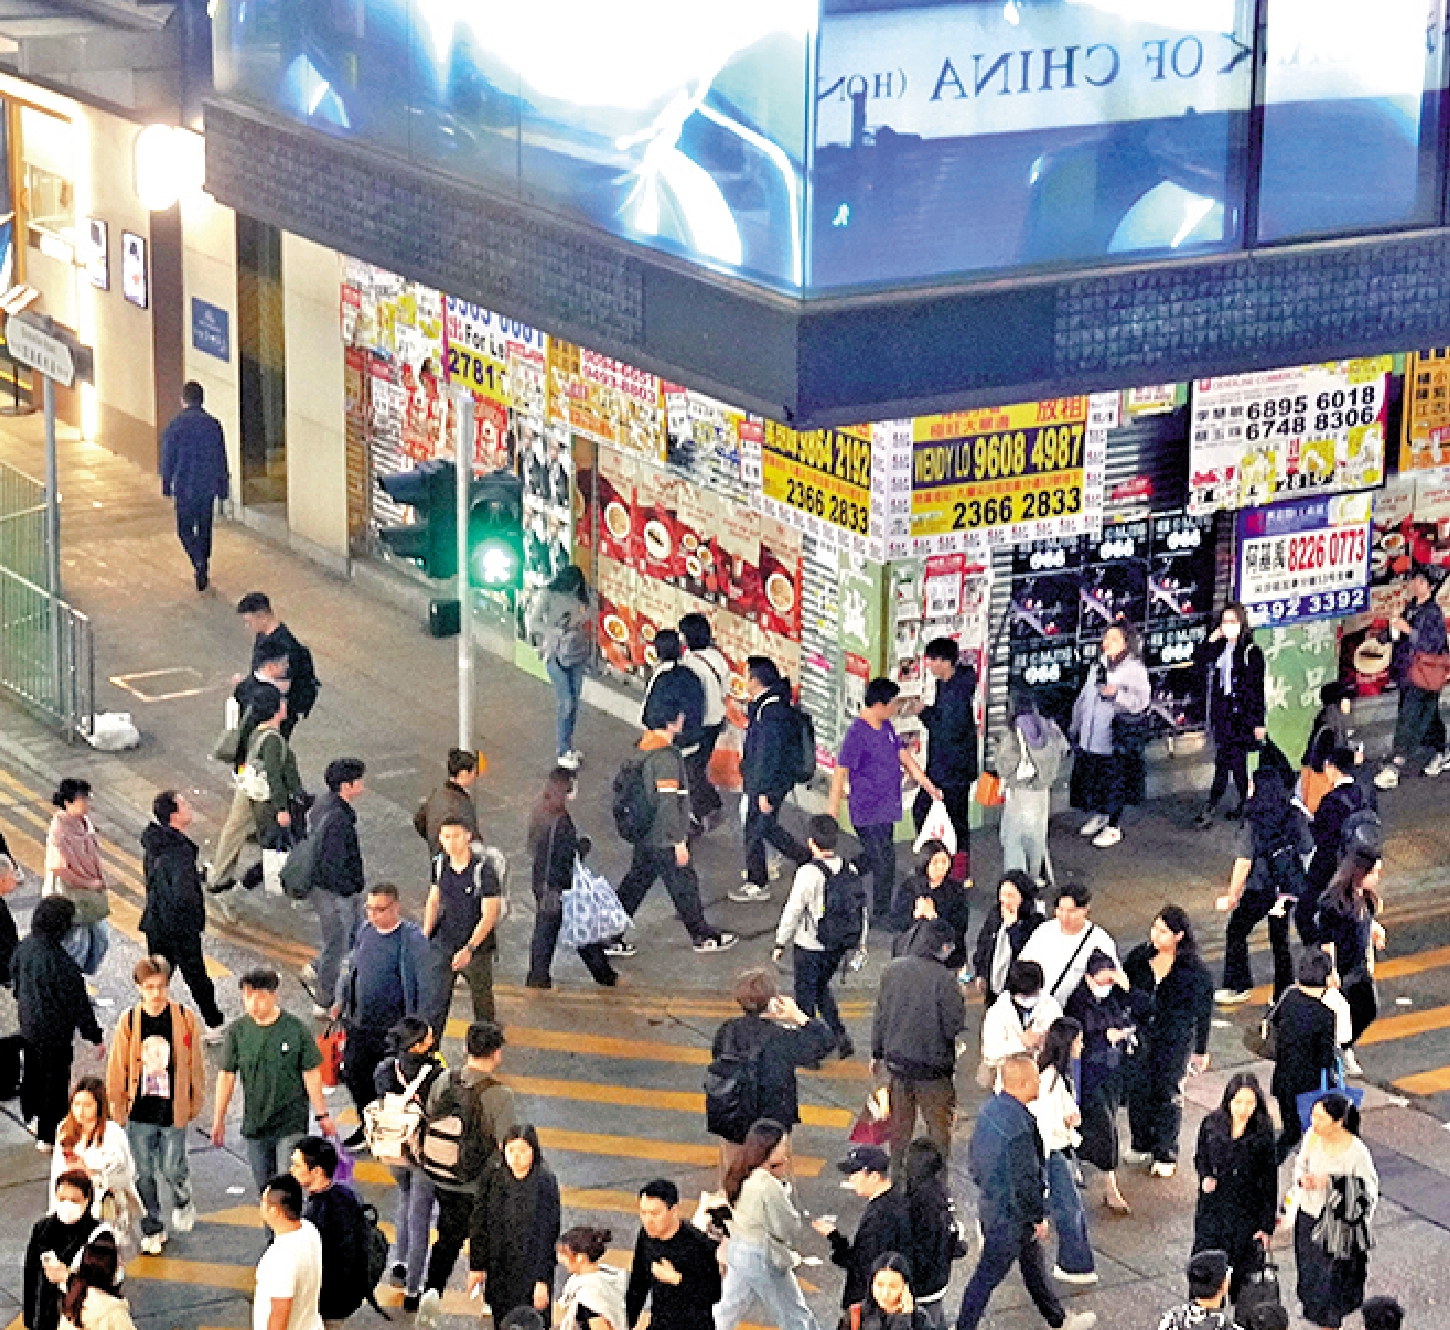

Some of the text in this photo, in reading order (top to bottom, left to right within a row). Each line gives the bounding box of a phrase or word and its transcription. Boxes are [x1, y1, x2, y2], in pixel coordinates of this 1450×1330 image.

[1245, 416, 1307, 441] 6748
[1313, 405, 1374, 431] 8306
[1247, 394, 1308, 420] 6895
[1316, 385, 1375, 410] 6018
[913, 444, 954, 484] WENDY
[973, 430, 1027, 481] 9608
[1031, 424, 1084, 472] 4987
[786, 478, 826, 517] 2366
[829, 495, 869, 535] 2833
[952, 495, 1013, 531] 2366
[1021, 487, 1082, 520] 2833
[1287, 533, 1327, 572] 8226
[1329, 526, 1366, 567] 0773
[1308, 588, 1365, 614] 3392
